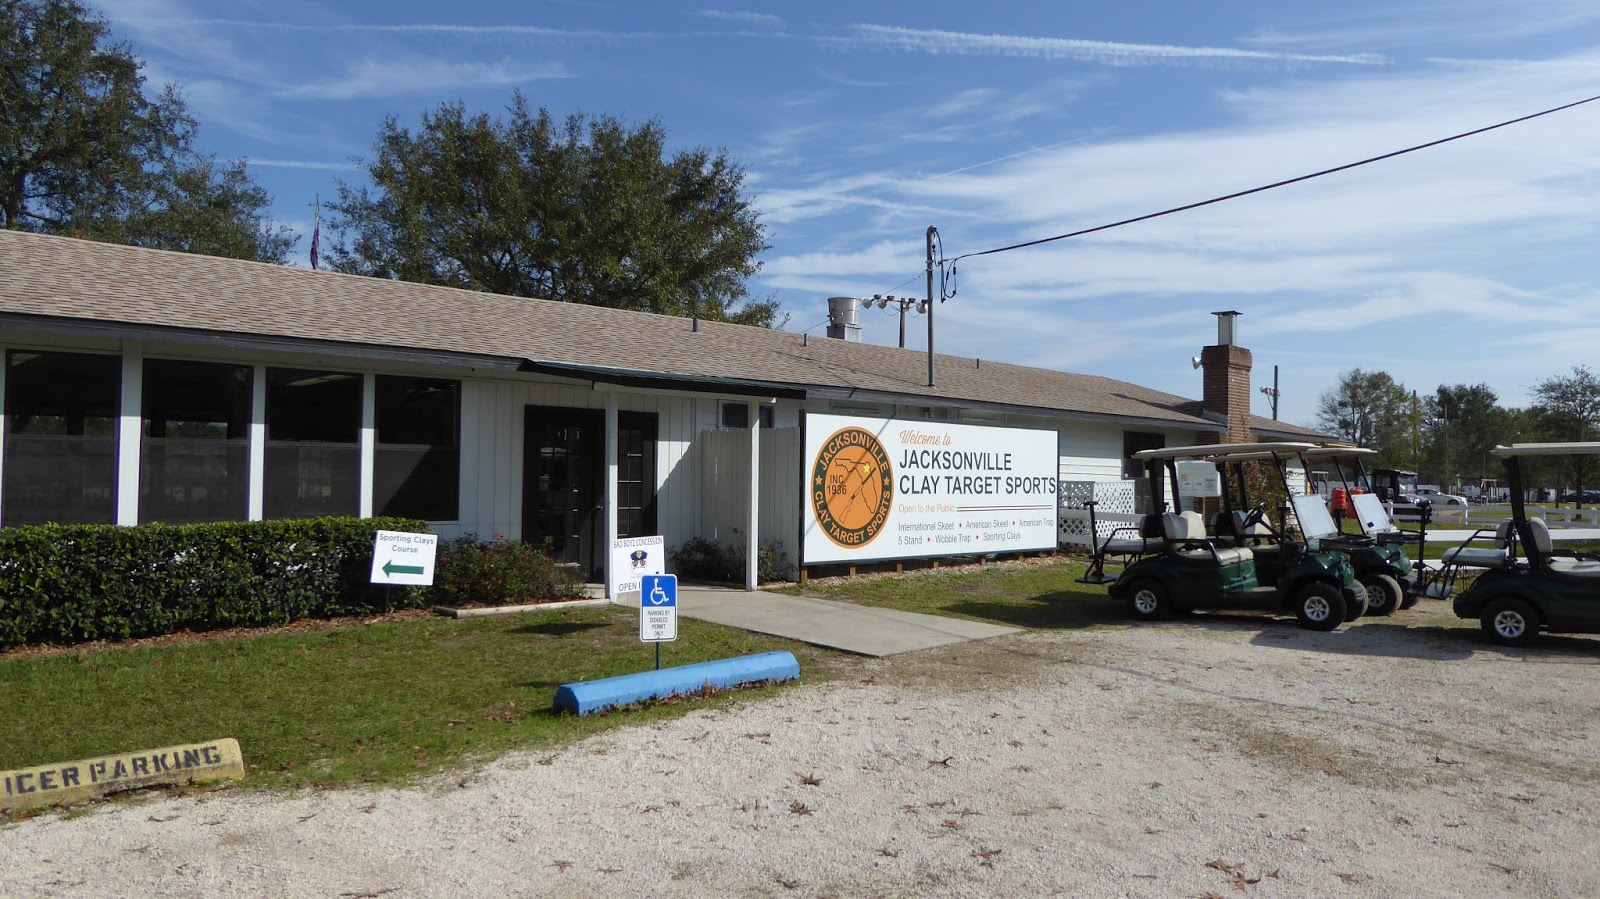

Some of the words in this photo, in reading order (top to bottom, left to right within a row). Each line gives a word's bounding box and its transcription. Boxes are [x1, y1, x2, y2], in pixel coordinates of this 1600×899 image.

[899, 430, 940, 446] Welcome
[943, 433, 952, 446] to
[819, 432, 888, 474] JACKSONVILLE
[899, 449, 1012, 471] JACKSONVILLE
[829, 475, 844, 485] INC
[899, 475, 940, 495] CLAY
[944, 475, 1002, 495] TARGET
[1006, 476, 1056, 495] SPORTS
[826, 485, 847, 495] 1936
[898, 504, 917, 514] Open
[918, 504, 924, 513] to
[925, 504, 935, 513] the
[937, 503, 955, 513] Public
[814, 490, 831, 524] CLAY
[829, 523, 865, 543] TARGET
[866, 490, 891, 536] SPORTS
[1018, 518, 1042, 527] American
[1043, 517, 1054, 527] Trap
[898, 522, 936, 532] International
[937, 521, 955, 531] Skeet
[965, 520, 992, 529] American
[993, 519, 1009, 529] Skeet
[380, 534, 411, 543] Sporting
[414, 537, 434, 545] Clays
[897, 536, 903, 545] 5
[904, 535, 923, 545] Stand
[935, 534, 958, 544] Wobble
[958, 533, 972, 543] Trap
[982, 532, 1006, 542] Sporting
[1006, 531, 1021, 540] Clays
[613, 540, 623, 548] BAD
[624, 539, 635, 548] BOYZ
[636, 537, 662, 546] CONCESSION
[392, 545, 418, 553] Course
[619, 582, 637, 591] OPEN
[4, 766, 81, 796] ICER
[89, 746, 222, 782] PARKING
